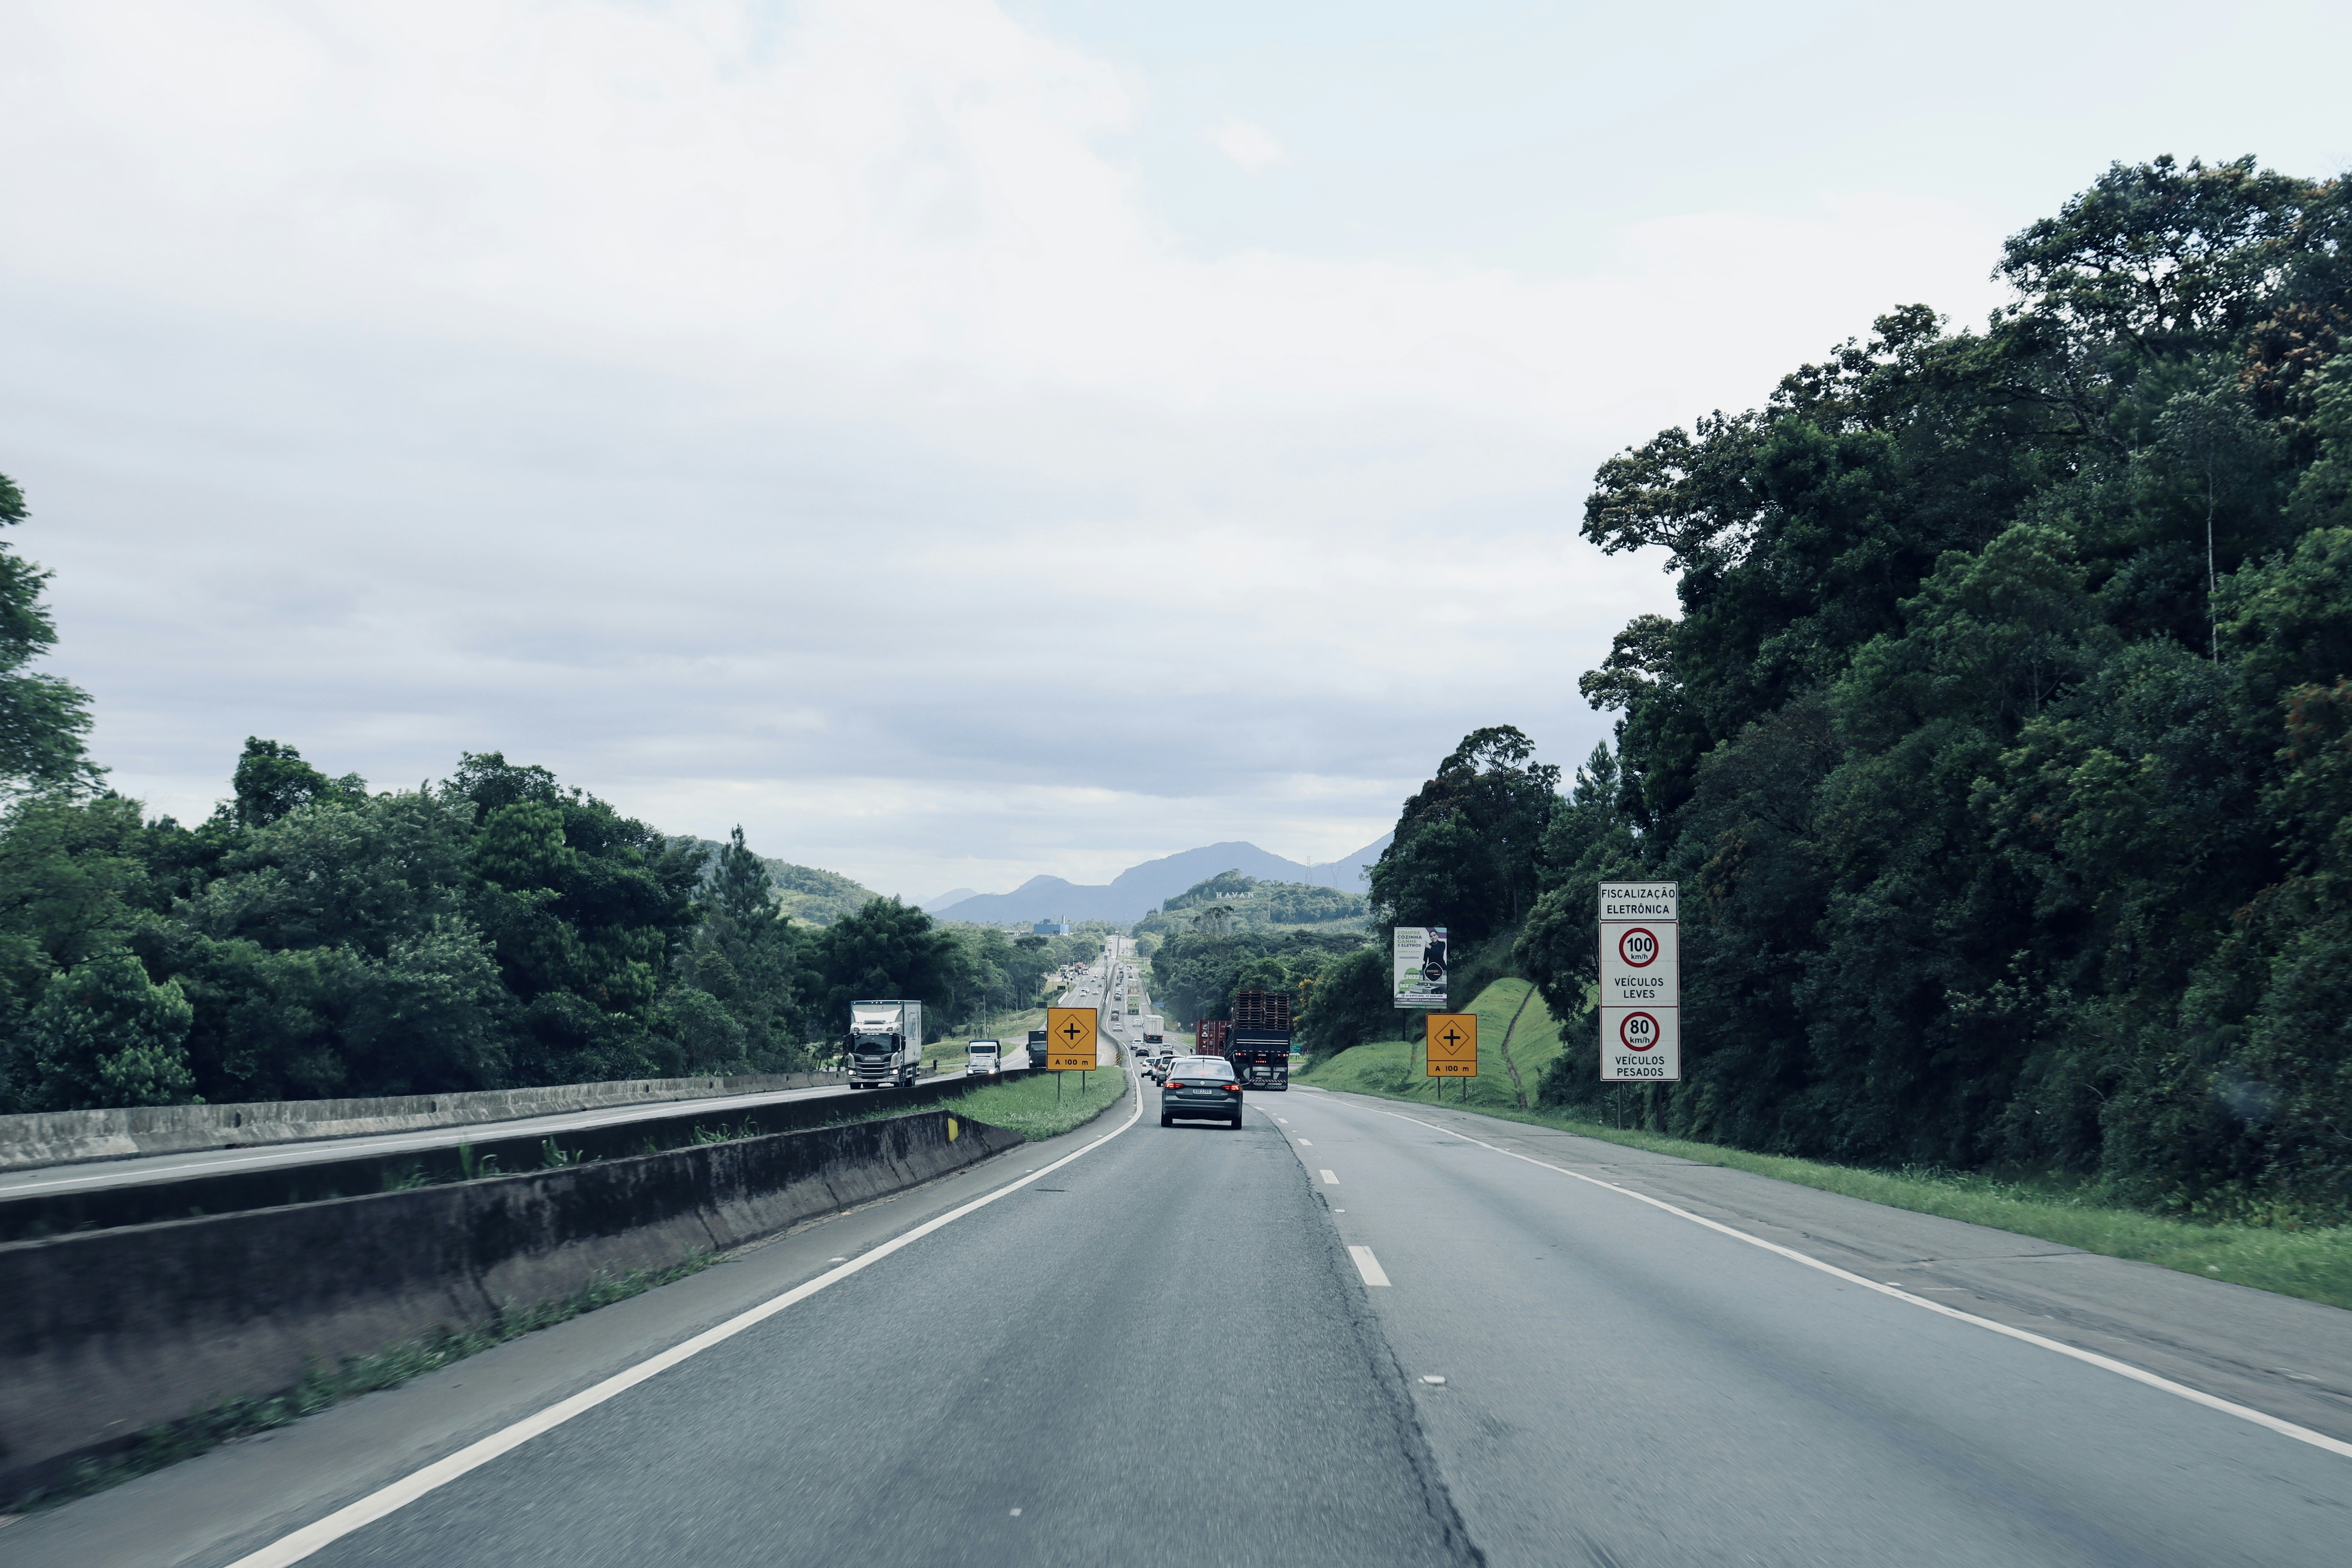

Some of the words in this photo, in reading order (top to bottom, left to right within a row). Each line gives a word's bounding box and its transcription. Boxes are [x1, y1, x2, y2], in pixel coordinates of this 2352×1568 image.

[1602, 887, 1675, 900] FISCALIZAÇÃO
[1607, 903, 1670, 914] ELETRÔNICA
[1627, 938, 1652, 952] 100
[1614, 975, 1664, 986] VEÍCULOS
[1624, 990, 1655, 998] LEVES
[1630, 1020, 1649, 1034] 80
[1615, 1054, 1664, 1065] VEÍCULOS
[1617, 1068, 1664, 1076] PESADOS
